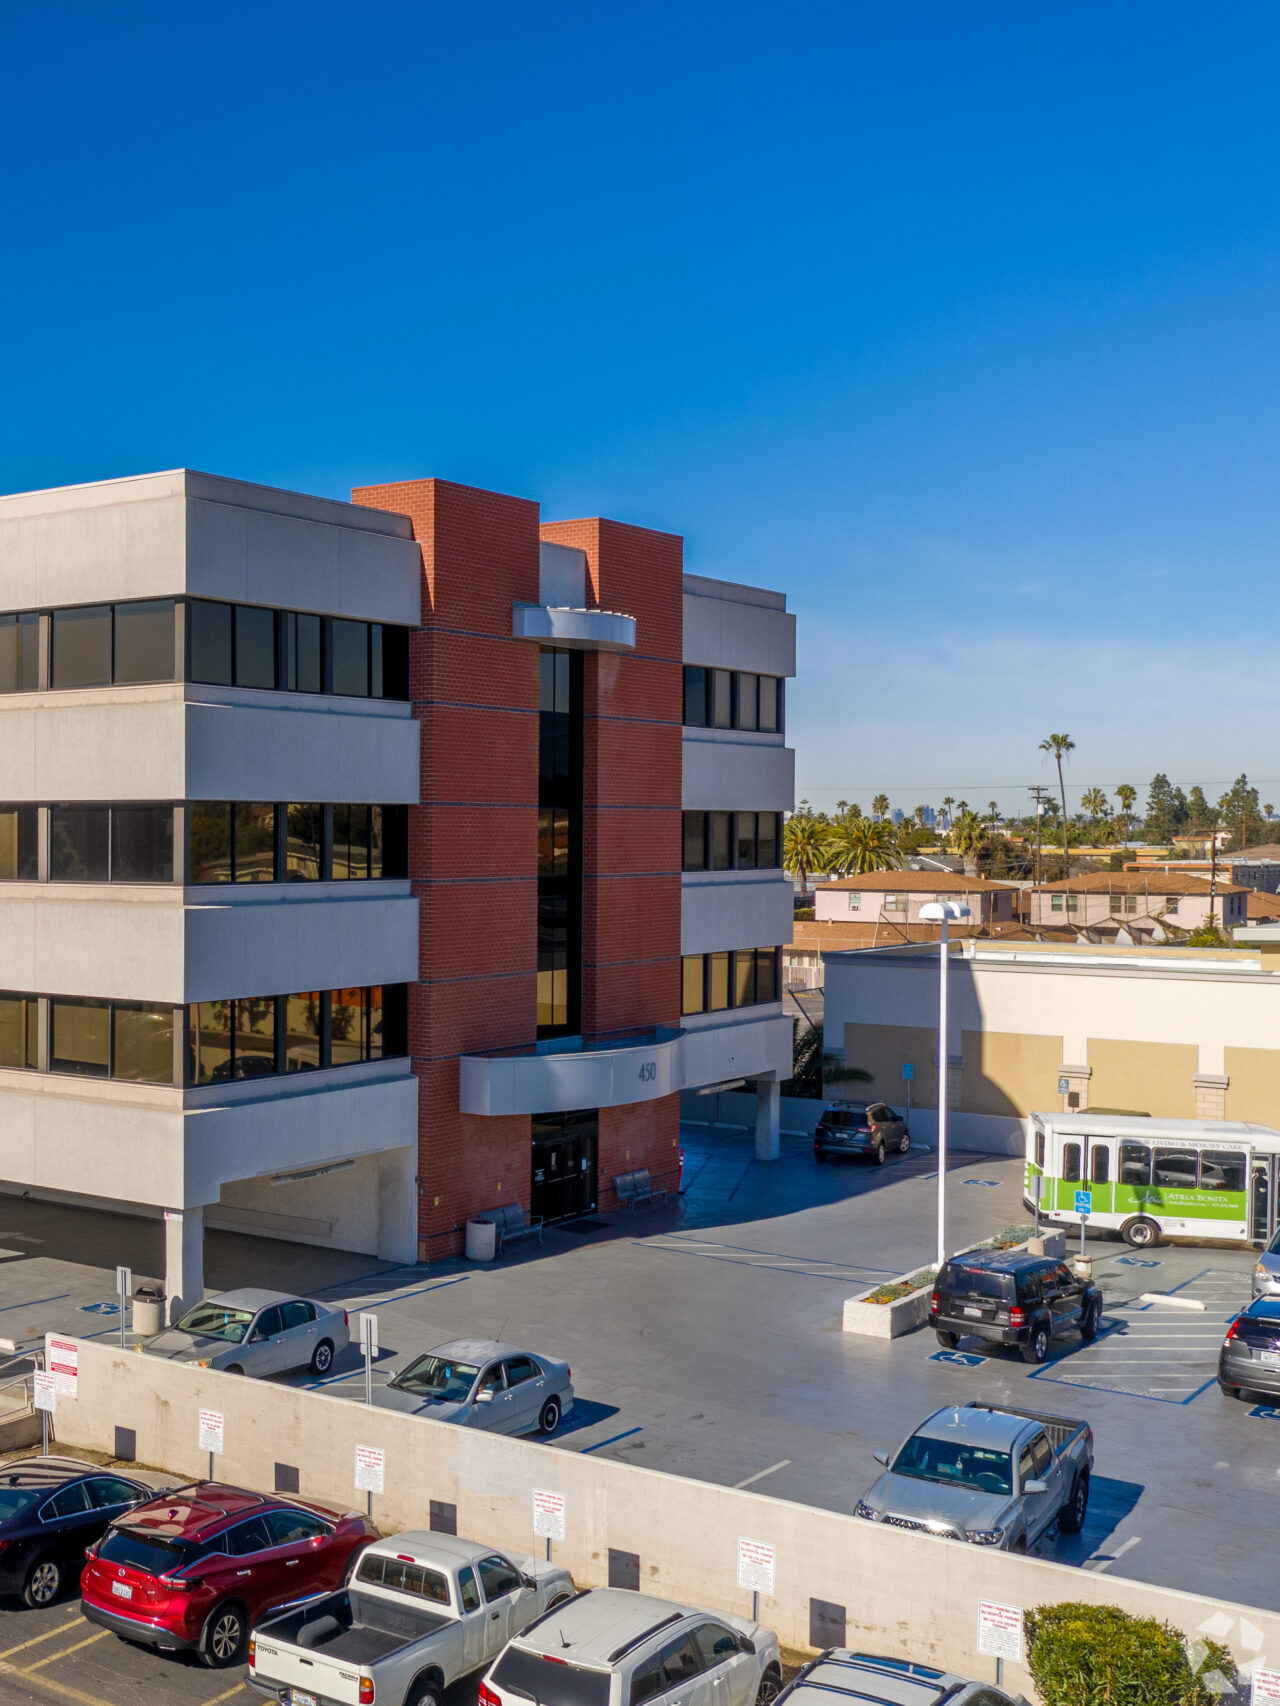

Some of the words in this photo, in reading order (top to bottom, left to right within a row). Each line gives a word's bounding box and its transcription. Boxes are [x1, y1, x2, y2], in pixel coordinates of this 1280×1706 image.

[639, 1062, 656, 1082] 450
[1168, 1193, 1195, 1201] ATRIA
[1197, 1194, 1228, 1203] BONITA
[257, 1644, 279, 1656] TOYOTA
[339, 1671, 358, 1681] TACOMA
